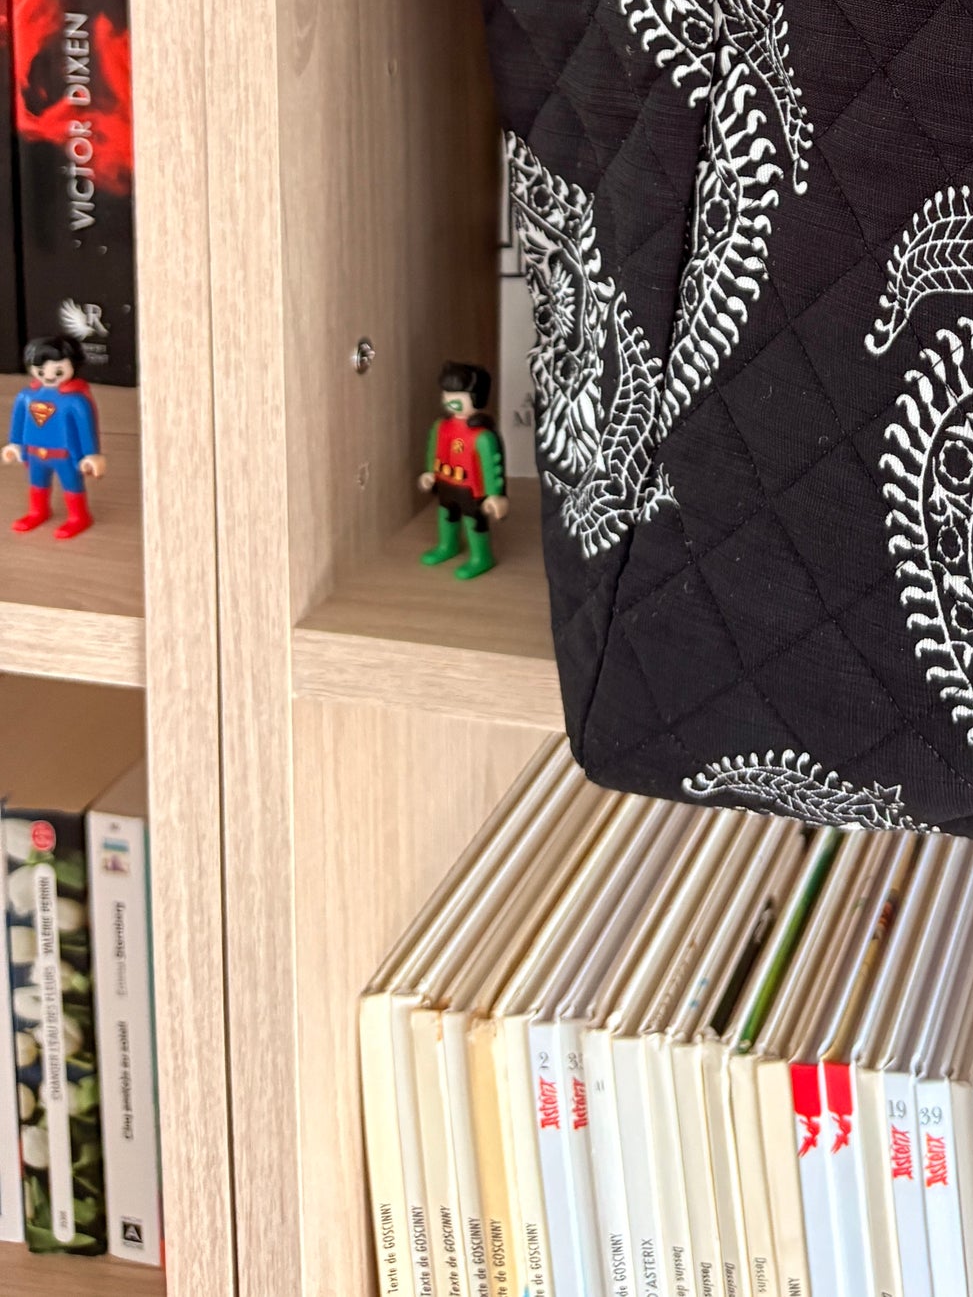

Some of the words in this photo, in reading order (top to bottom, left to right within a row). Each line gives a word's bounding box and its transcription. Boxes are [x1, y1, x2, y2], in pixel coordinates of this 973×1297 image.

[63, 12, 91, 106] DIXEN
[65, 119, 96, 231] VICTOR
[538, 1051, 549, 1069] 2
[888, 1099, 907, 1119] 19
[920, 1105, 943, 1125] 39
[379, 1203, 396, 1250] GOSCINNY
[410, 1205, 428, 1253] GOSCINNY
[439, 1205, 456, 1253] GOSCINNY
[468, 1216, 486, 1265] GOSCINNY
[489, 1218, 506, 1267] GOSCINNY
[384, 1252, 397, 1264] de
[415, 1255, 429, 1268] de
[444, 1256, 457, 1268] de
[525, 1222, 542, 1271] GOSCINNY
[609, 1232, 627, 1282] GOSCINNY
[473, 1268, 487, 1280] de
[493, 1270, 507, 1283] de
[530, 1273, 544, 1286] de
